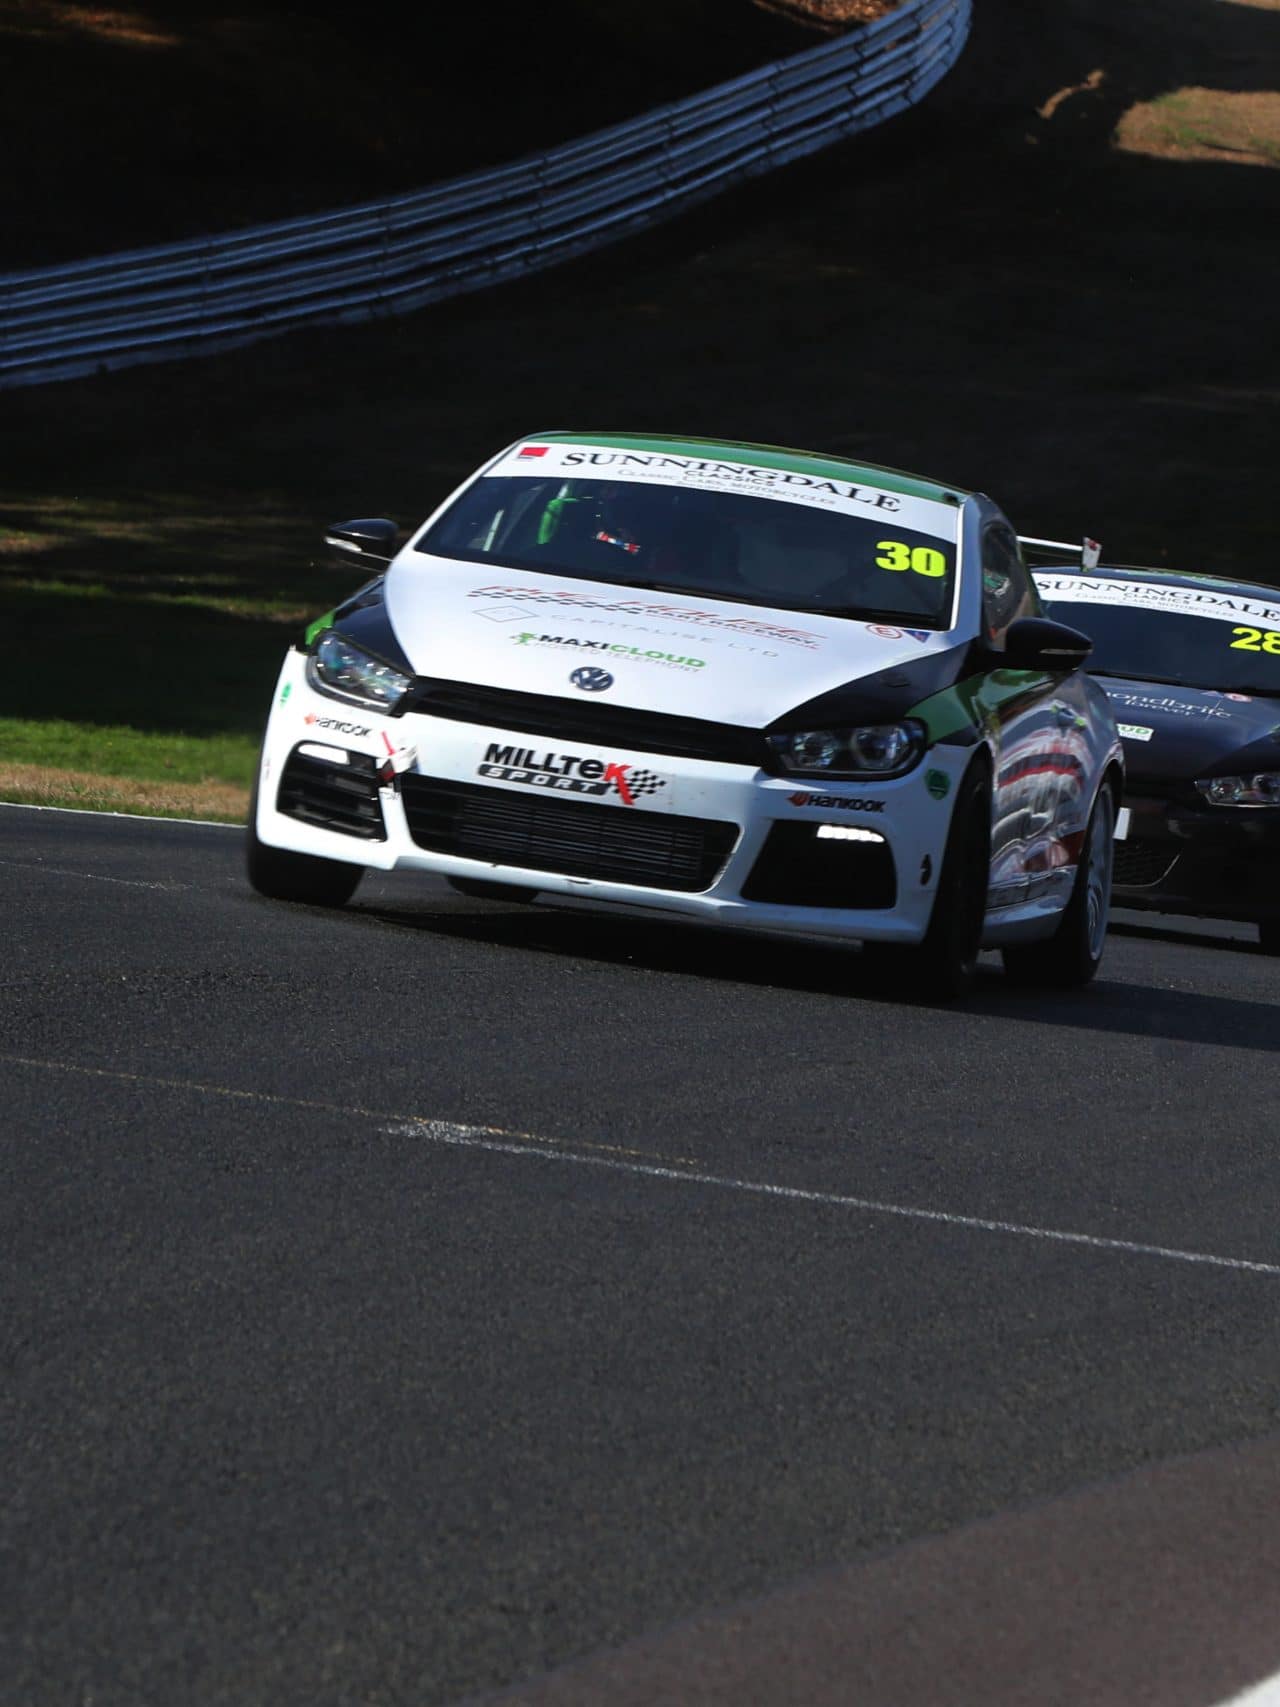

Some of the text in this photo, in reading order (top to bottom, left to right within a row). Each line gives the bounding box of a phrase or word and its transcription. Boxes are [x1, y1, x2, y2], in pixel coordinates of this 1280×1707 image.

[561, 452, 901, 512] SUNNINGDALE
[684, 470, 777, 487] CLASSICS
[875, 541, 946, 577] 30
[1037, 580, 1280, 622] SUNNINGDALE
[539, 634, 706, 668] MAXICLOUD
[1106, 691, 1231, 719] ondbrite
[486, 767, 598, 793] SPORT
